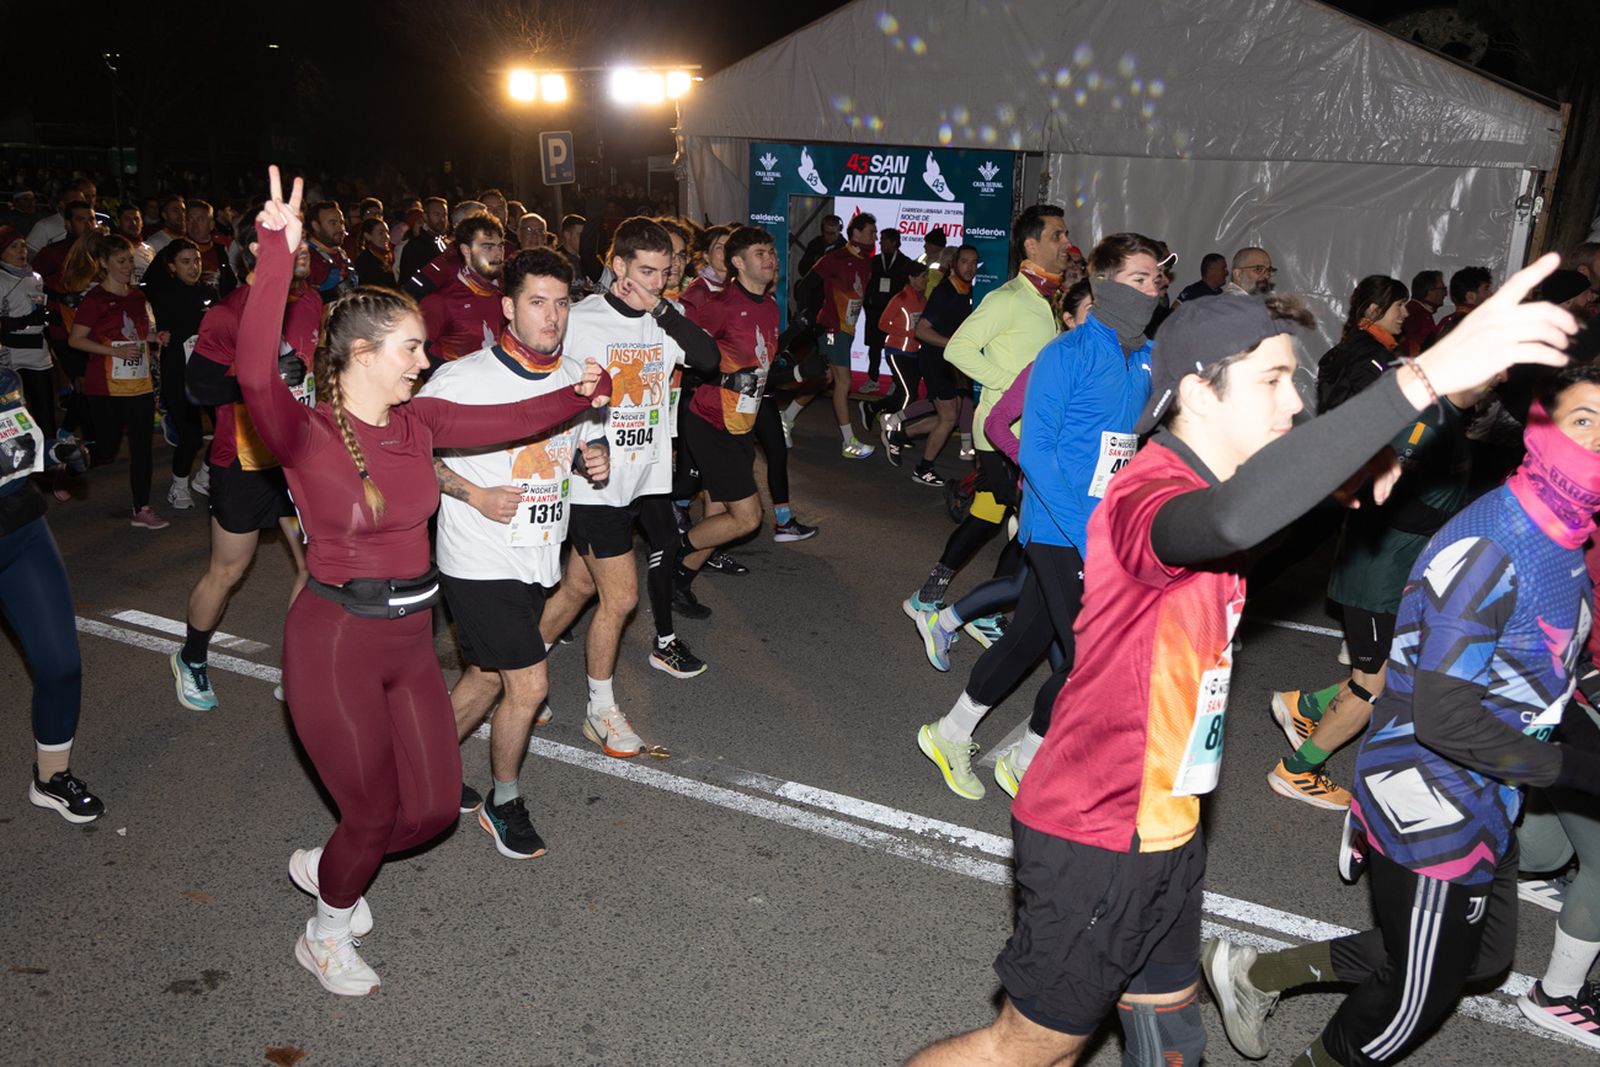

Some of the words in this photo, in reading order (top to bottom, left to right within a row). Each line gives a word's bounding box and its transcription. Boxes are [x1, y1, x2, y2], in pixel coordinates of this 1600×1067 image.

[548, 138, 567, 178] P
[847, 153, 870, 174] 43
[869, 154, 909, 174] SAN
[807, 172, 818, 187] 43
[840, 171, 905, 195] ANTÓN
[932, 178, 945, 192] 43
[898, 221, 928, 235] SAN
[610, 347, 661, 362] INSTANTE
[615, 427, 653, 447] 3504
[1108, 449, 1121, 457] SAN
[530, 486, 551, 494] NOCHE
[528, 501, 563, 524] 1313
[1206, 700, 1222, 713] SAN
[1205, 715, 1224, 750] 8
